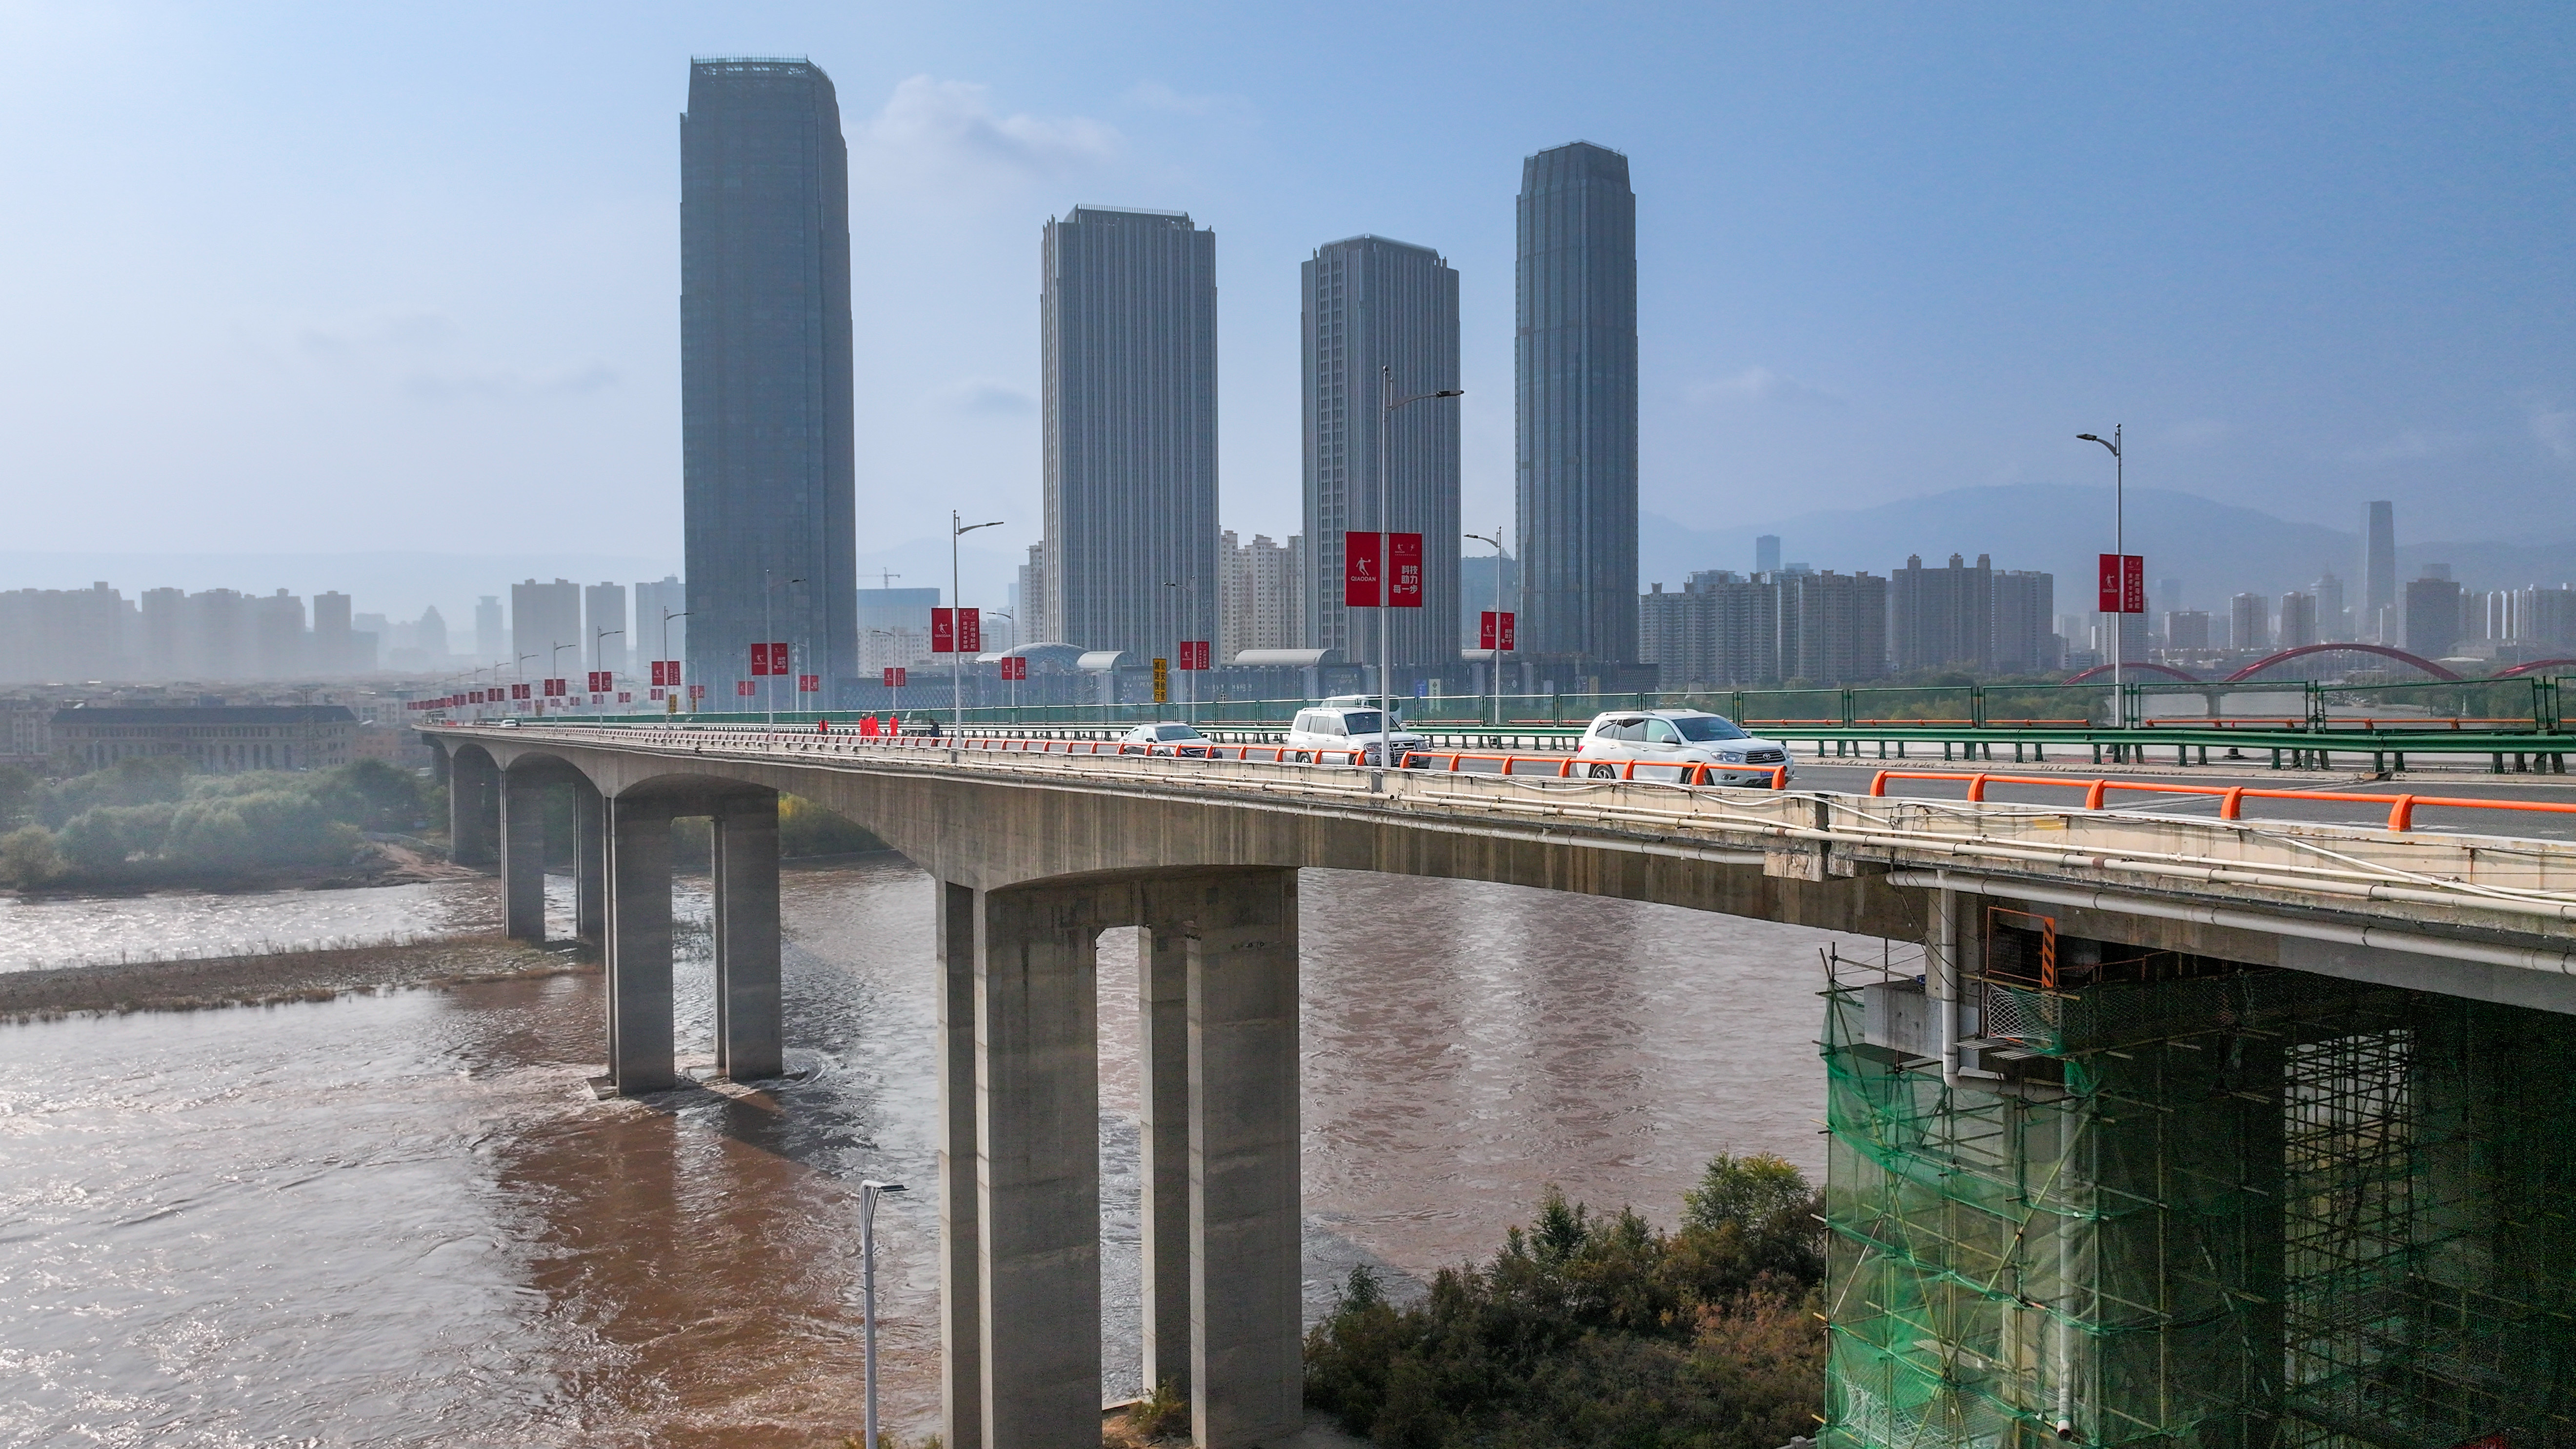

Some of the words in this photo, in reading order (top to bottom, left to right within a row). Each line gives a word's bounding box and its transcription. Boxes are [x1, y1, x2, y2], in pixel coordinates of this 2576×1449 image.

[1401, 565, 1418, 575] 科技
[1401, 575, 1418, 584] 助力
[1393, 585, 1418, 594] 每一步
